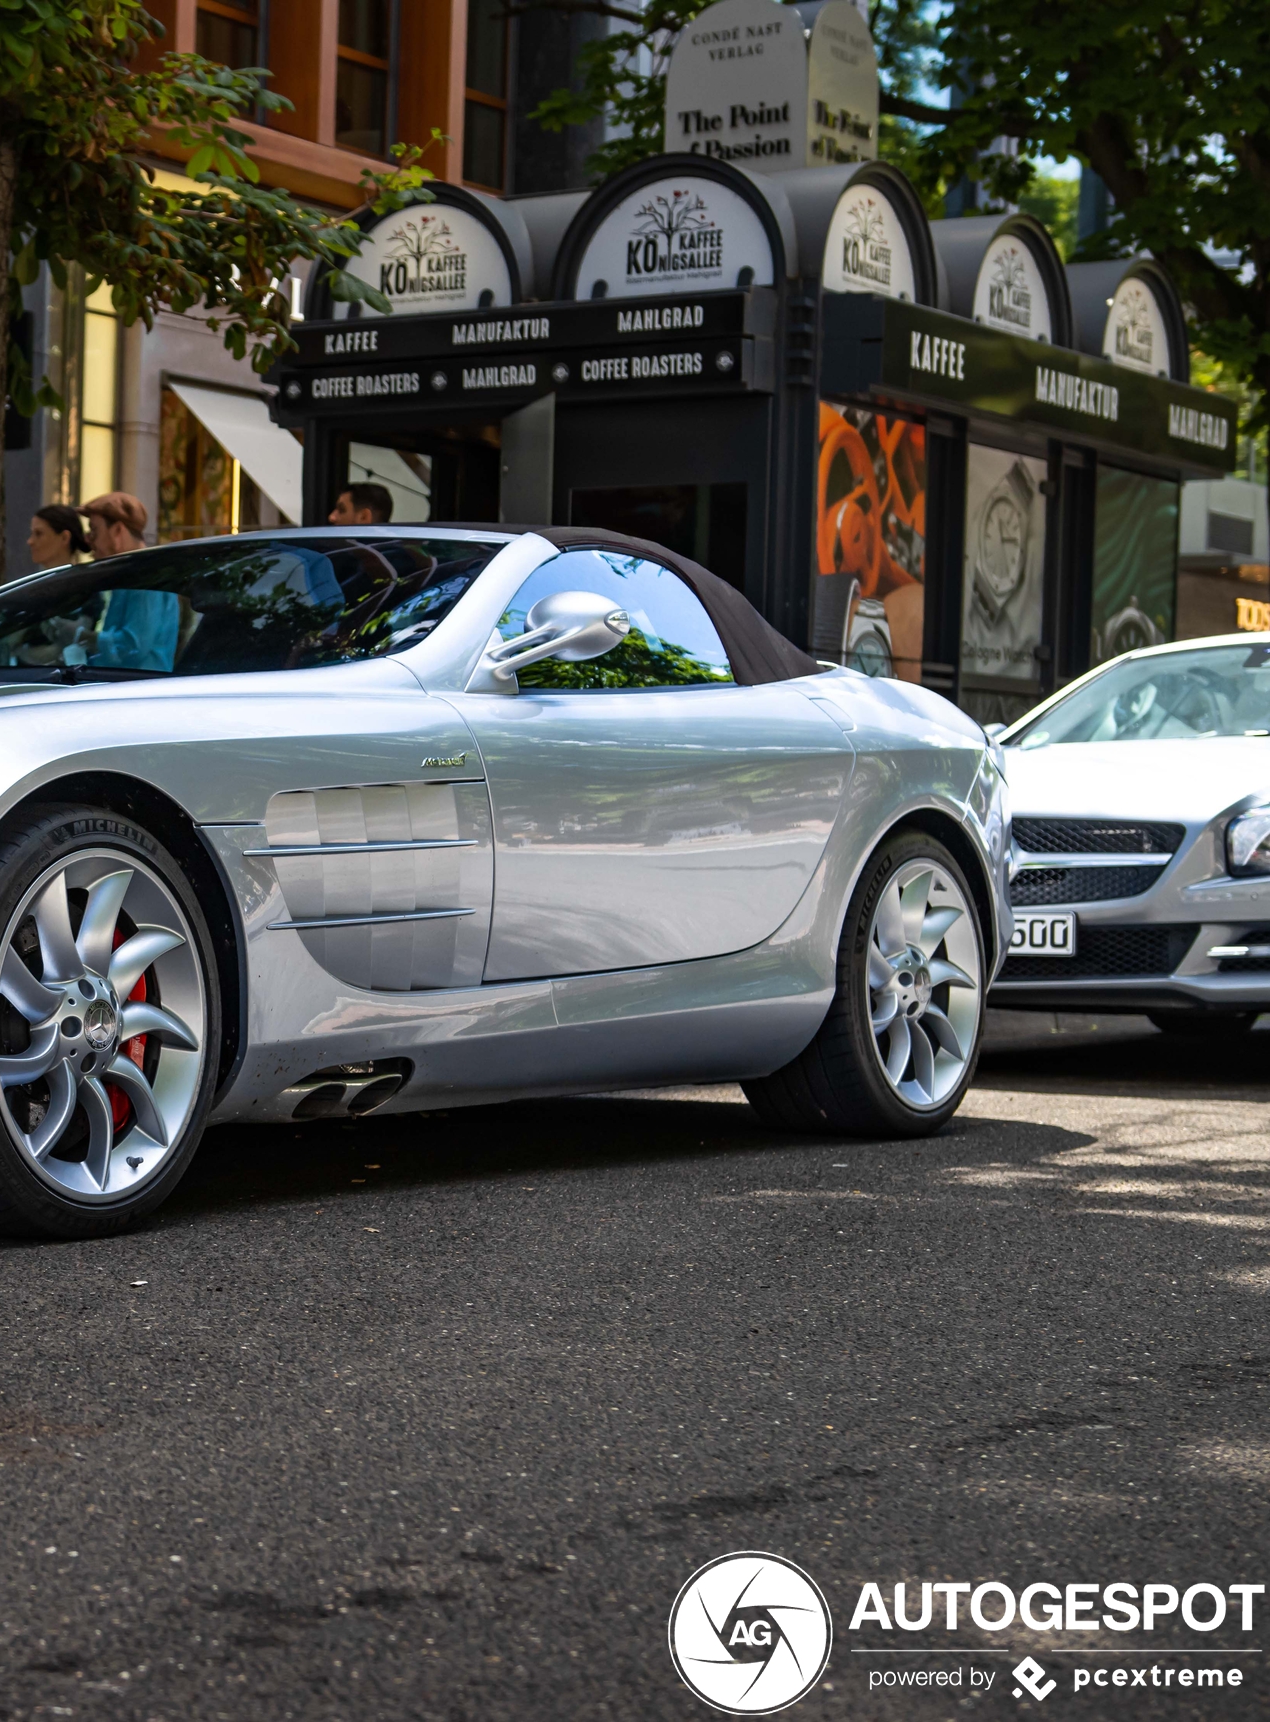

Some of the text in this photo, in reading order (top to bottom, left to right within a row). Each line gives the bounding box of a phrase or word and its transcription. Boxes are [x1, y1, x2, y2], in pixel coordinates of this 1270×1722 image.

[691, 21, 783, 46] CONDÉ NAST
[709, 43, 764, 61] VERLAG
[678, 101, 790, 135] The Point
[704, 134, 791, 160] Passion
[679, 228, 723, 250] KAFFEE
[427, 253, 467, 273] KAFFEE
[325, 305, 704, 354] KAFFEE MANUFAKTUR MAHLGRAD
[311, 353, 703, 399] COFFEE ROASTERS MAHLGRAD COFFEE ROASTERS
[910, 331, 1228, 450] KAFFEE MANUFAKTUR MAHLGRAD
[73, 819, 156, 852] MICHELIN
